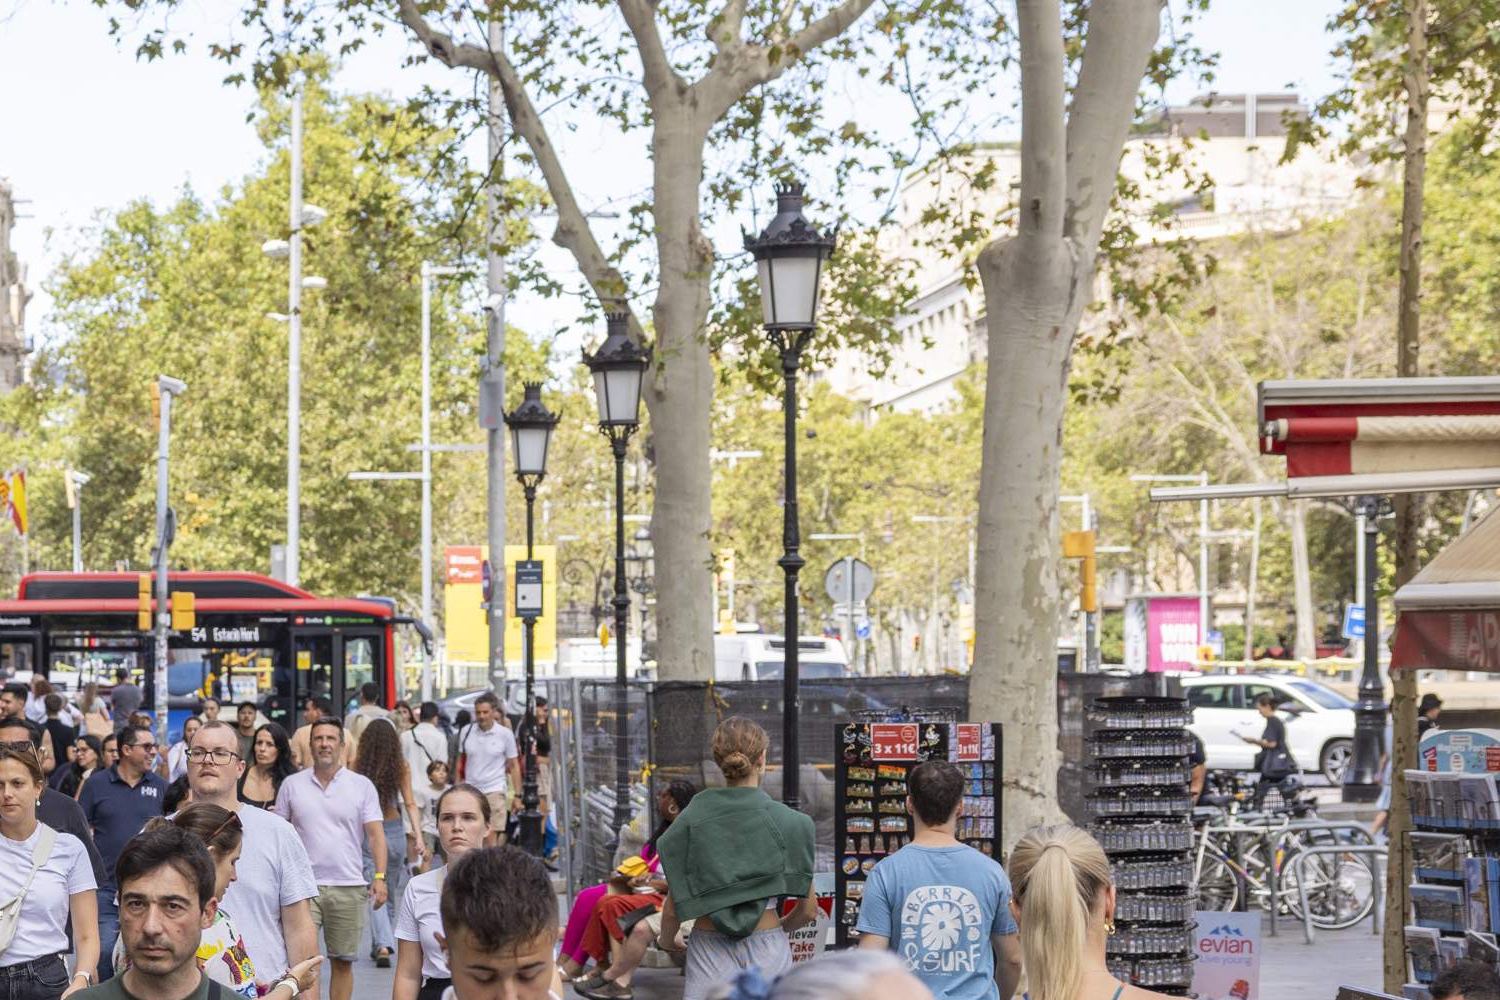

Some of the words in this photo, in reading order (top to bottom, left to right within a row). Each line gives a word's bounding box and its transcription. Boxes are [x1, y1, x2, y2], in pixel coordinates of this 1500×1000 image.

[191, 627, 206, 642] 54
[874, 744, 882, 754] 3
[884, 745, 893, 754] x
[896, 744, 915, 754] 11€
[1200, 936, 1252, 953] evian
[923, 943, 981, 972] SURF
